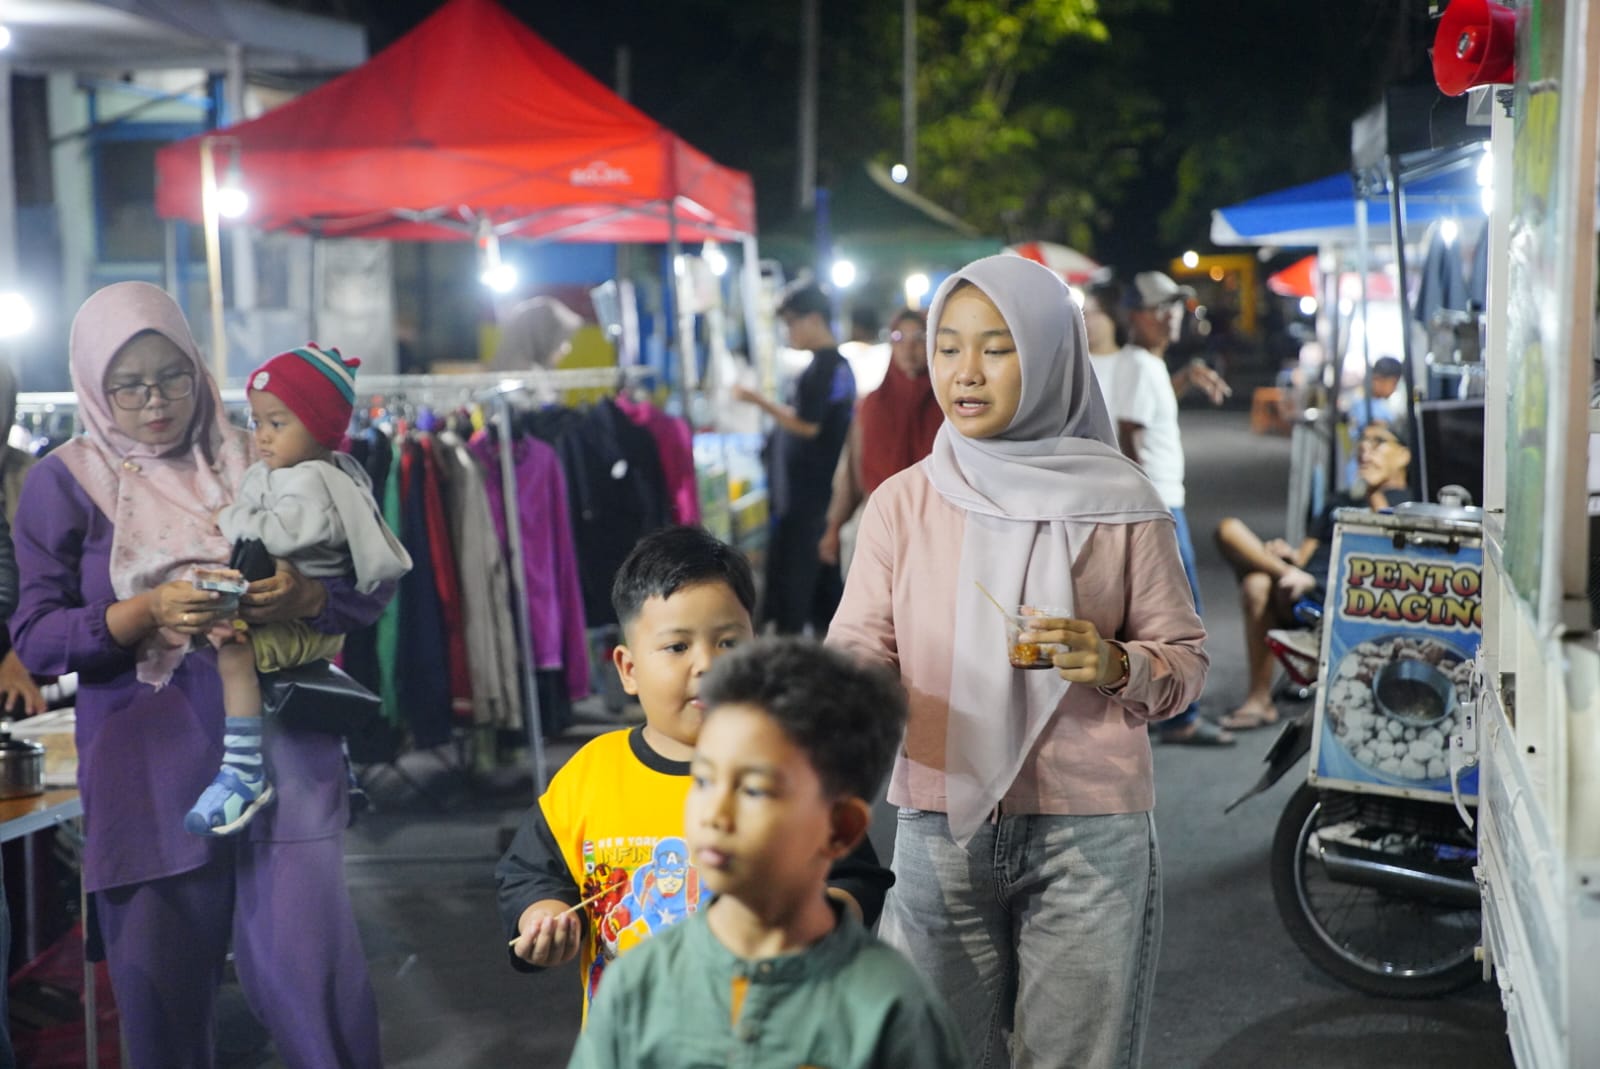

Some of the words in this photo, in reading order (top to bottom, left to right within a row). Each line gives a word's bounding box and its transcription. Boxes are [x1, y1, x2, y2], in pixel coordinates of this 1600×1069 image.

[1348, 557, 1482, 597] PENTO
[598, 837, 624, 848] NEW
[628, 836, 658, 848] YORK
[666, 852, 678, 865] A
